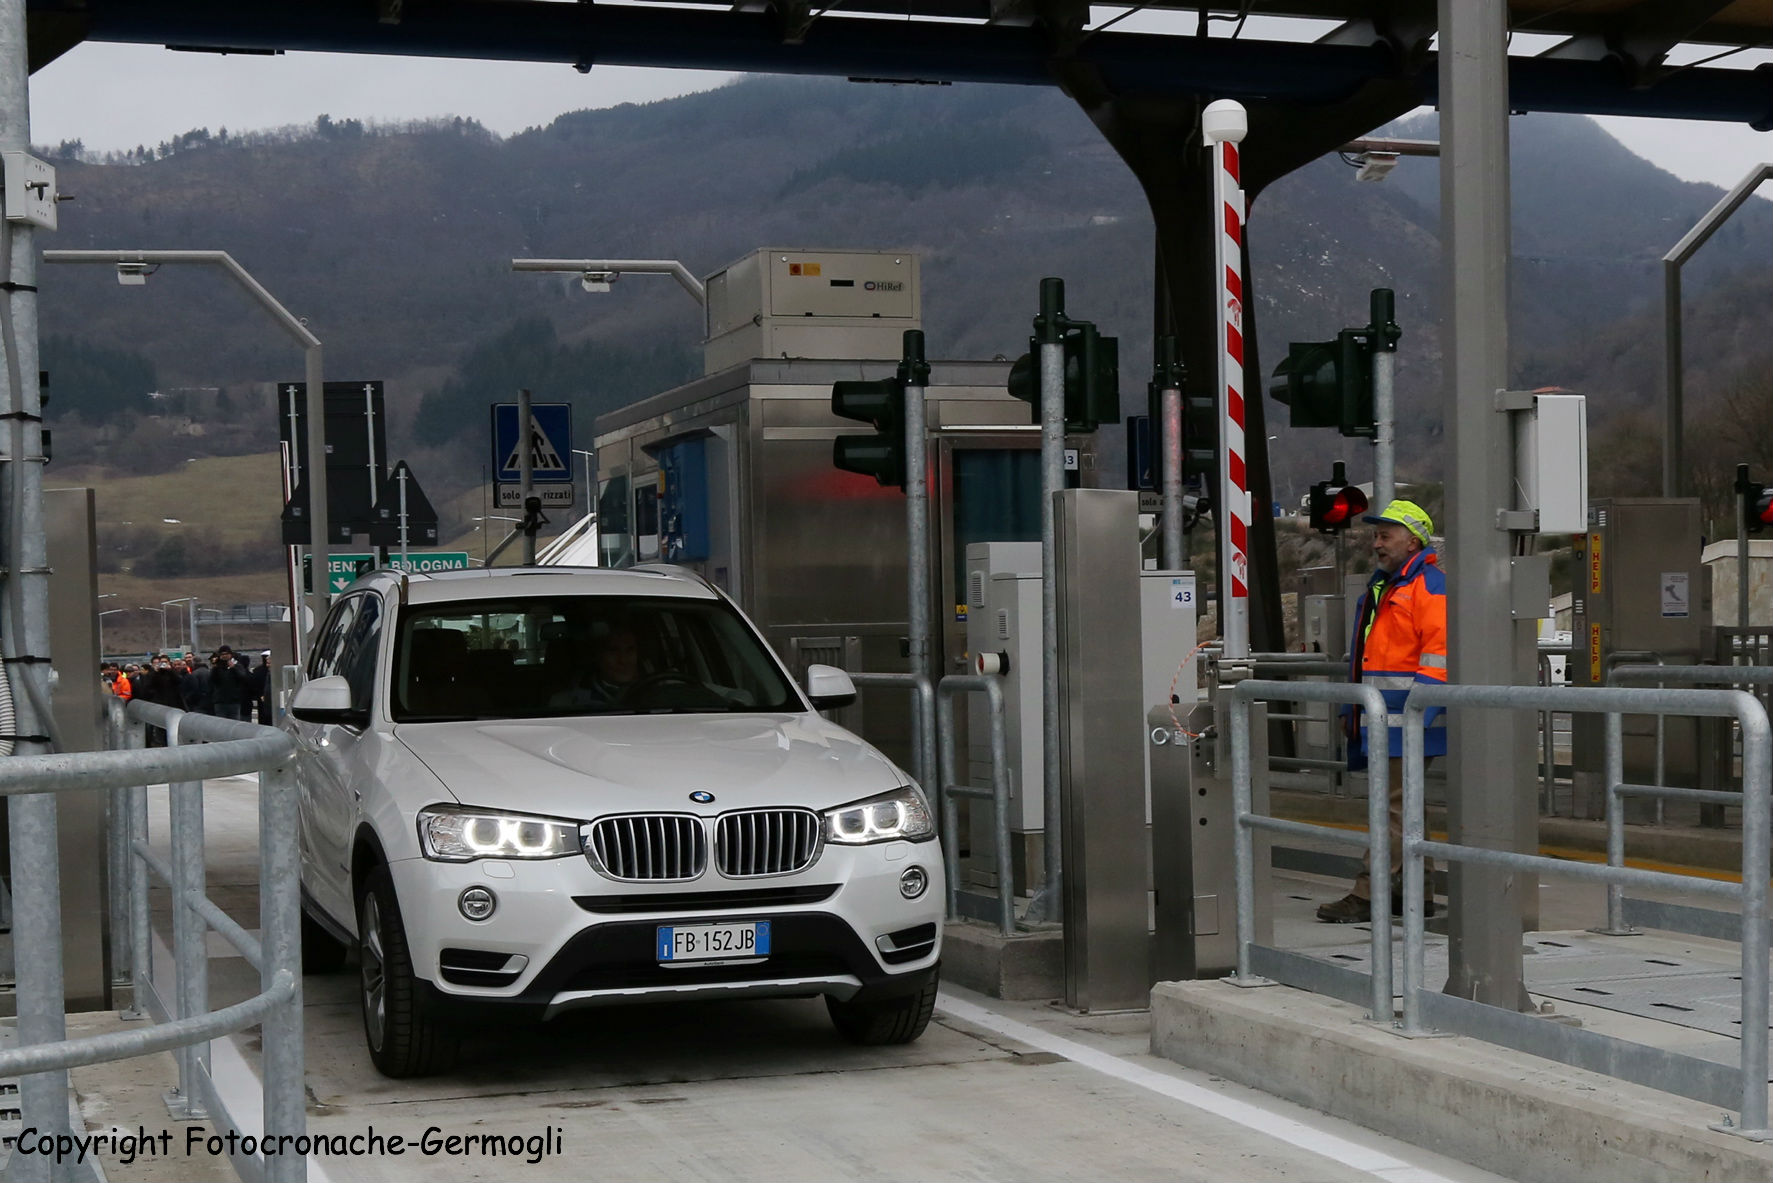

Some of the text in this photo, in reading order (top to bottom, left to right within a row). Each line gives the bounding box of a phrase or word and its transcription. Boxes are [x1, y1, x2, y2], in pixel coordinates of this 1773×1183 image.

[502, 490, 571, 499] solo rizzati
[1175, 591, 1192, 602] 43
[674, 932, 696, 953] FB
